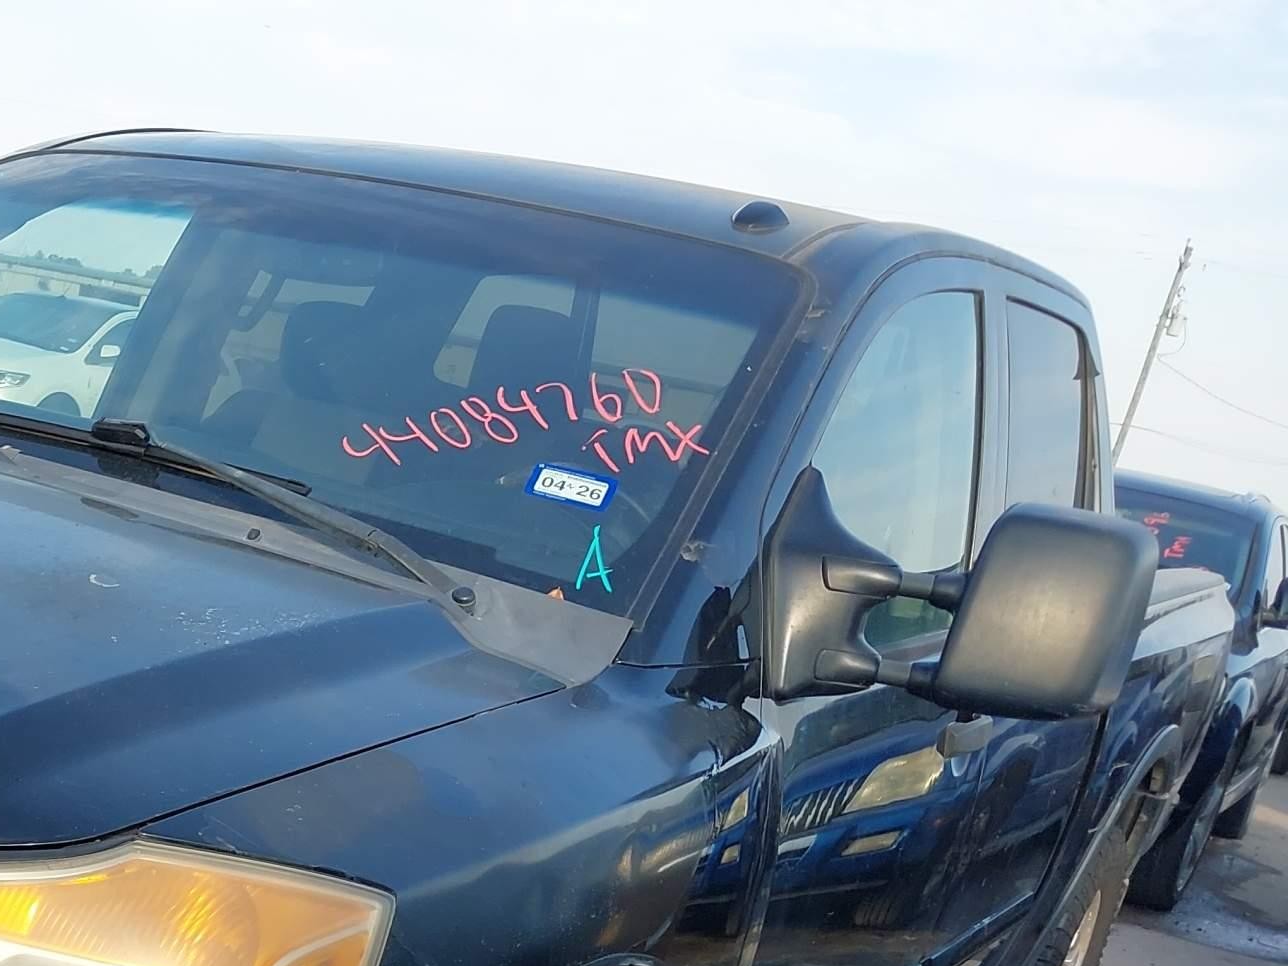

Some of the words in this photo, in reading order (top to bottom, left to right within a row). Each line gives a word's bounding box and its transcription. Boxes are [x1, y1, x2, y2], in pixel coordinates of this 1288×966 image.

[343, 368, 662, 466] 44084760
[541, 476, 567, 491] 04
[575, 484, 603, 500] 26
[575, 524, 615, 592] A
